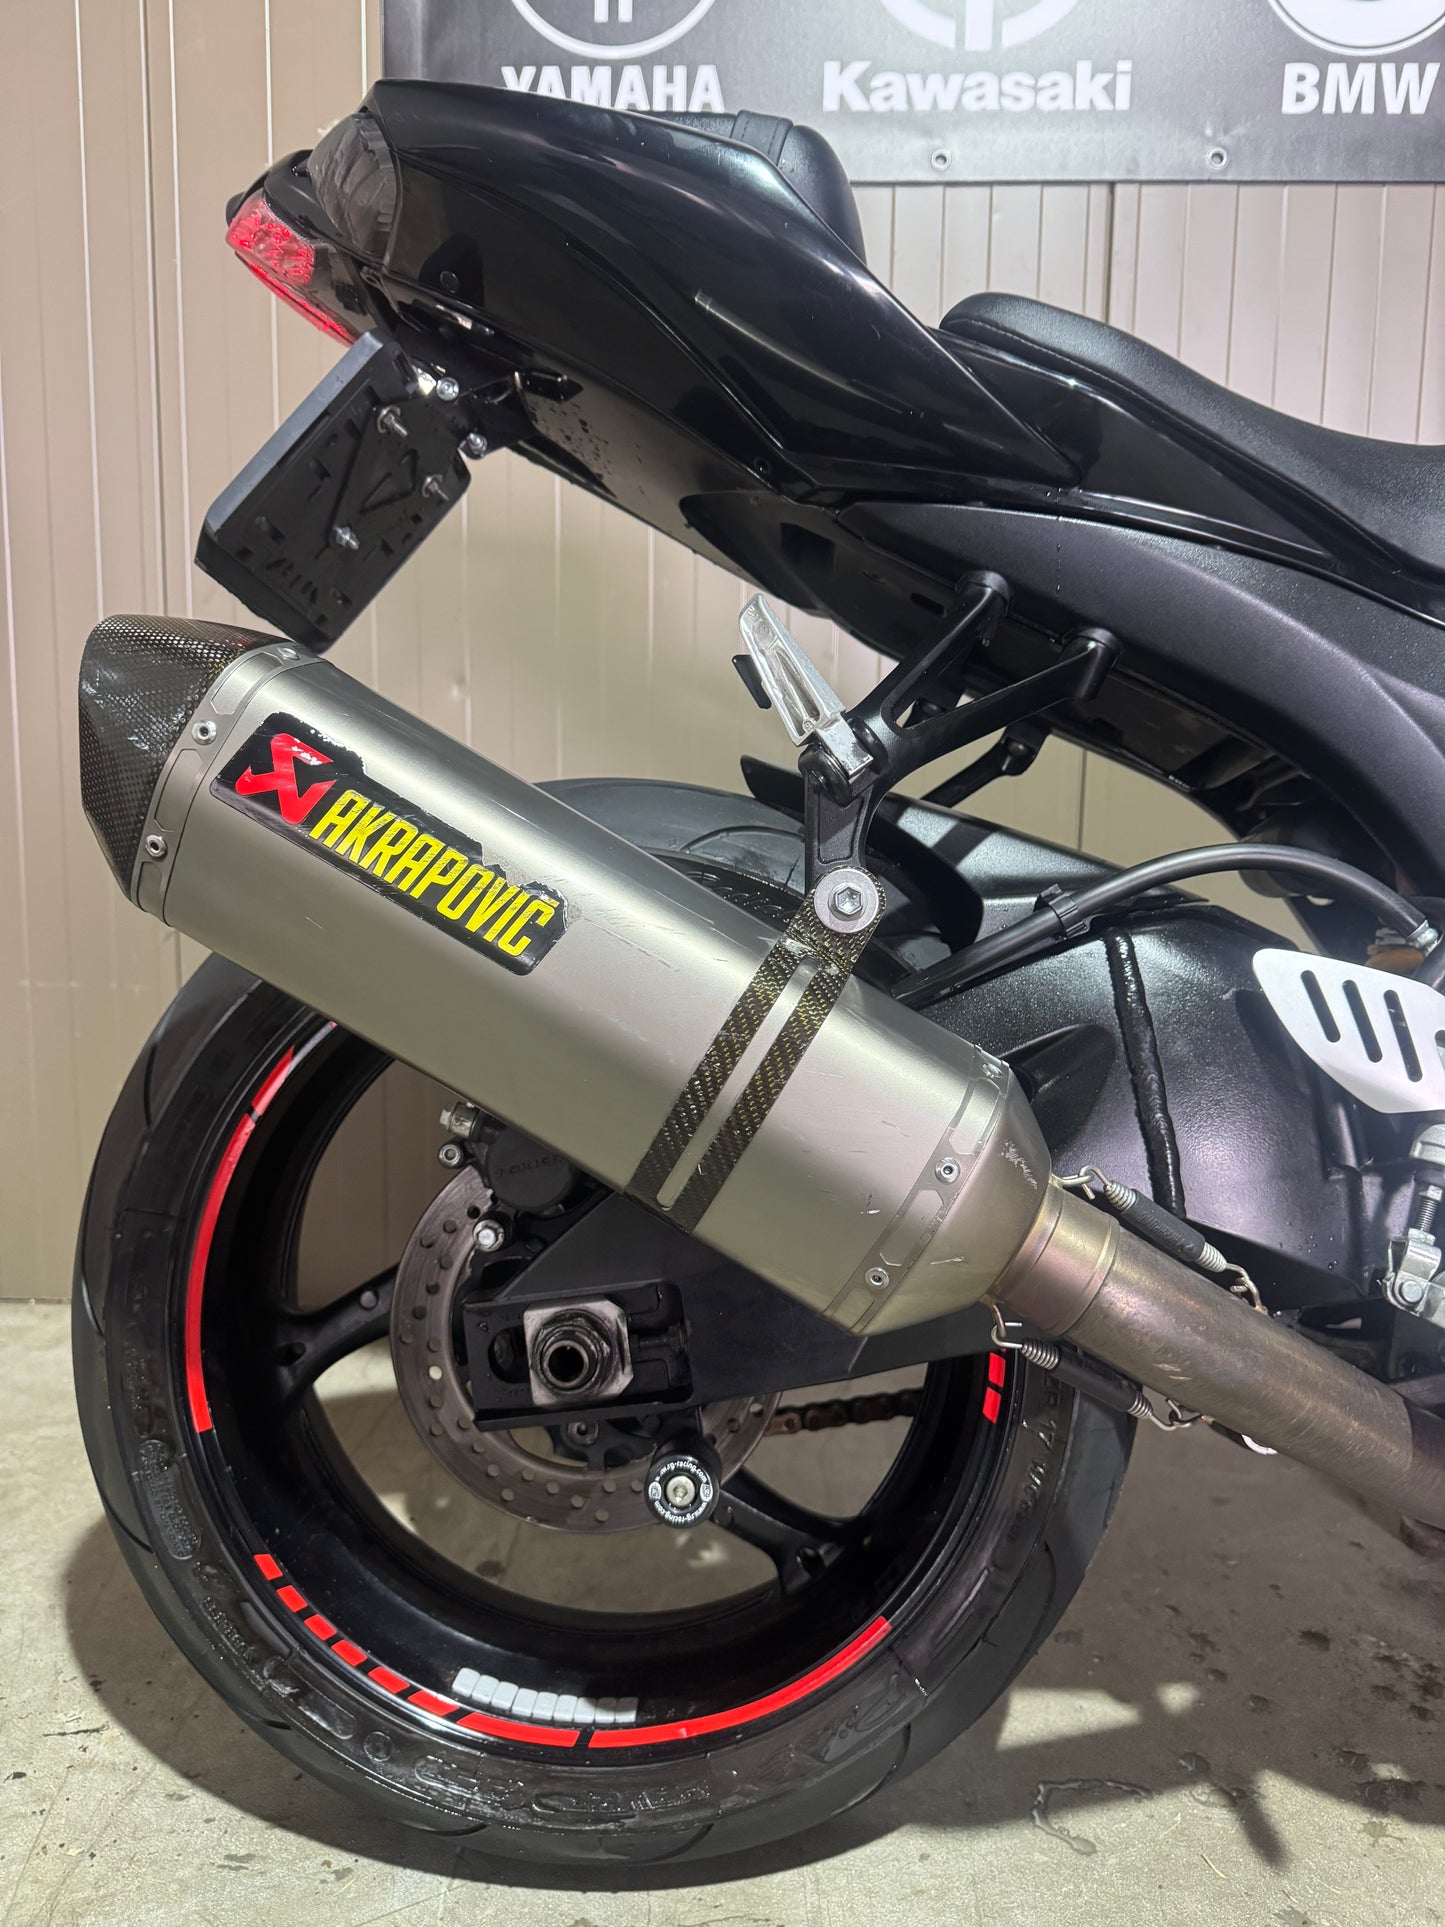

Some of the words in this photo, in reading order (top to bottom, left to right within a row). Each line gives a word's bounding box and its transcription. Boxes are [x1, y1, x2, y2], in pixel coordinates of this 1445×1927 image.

[500, 64, 726, 114] YAMAHA
[822, 59, 1133, 112] Kawasaki
[1281, 62, 1441, 115] BMW
